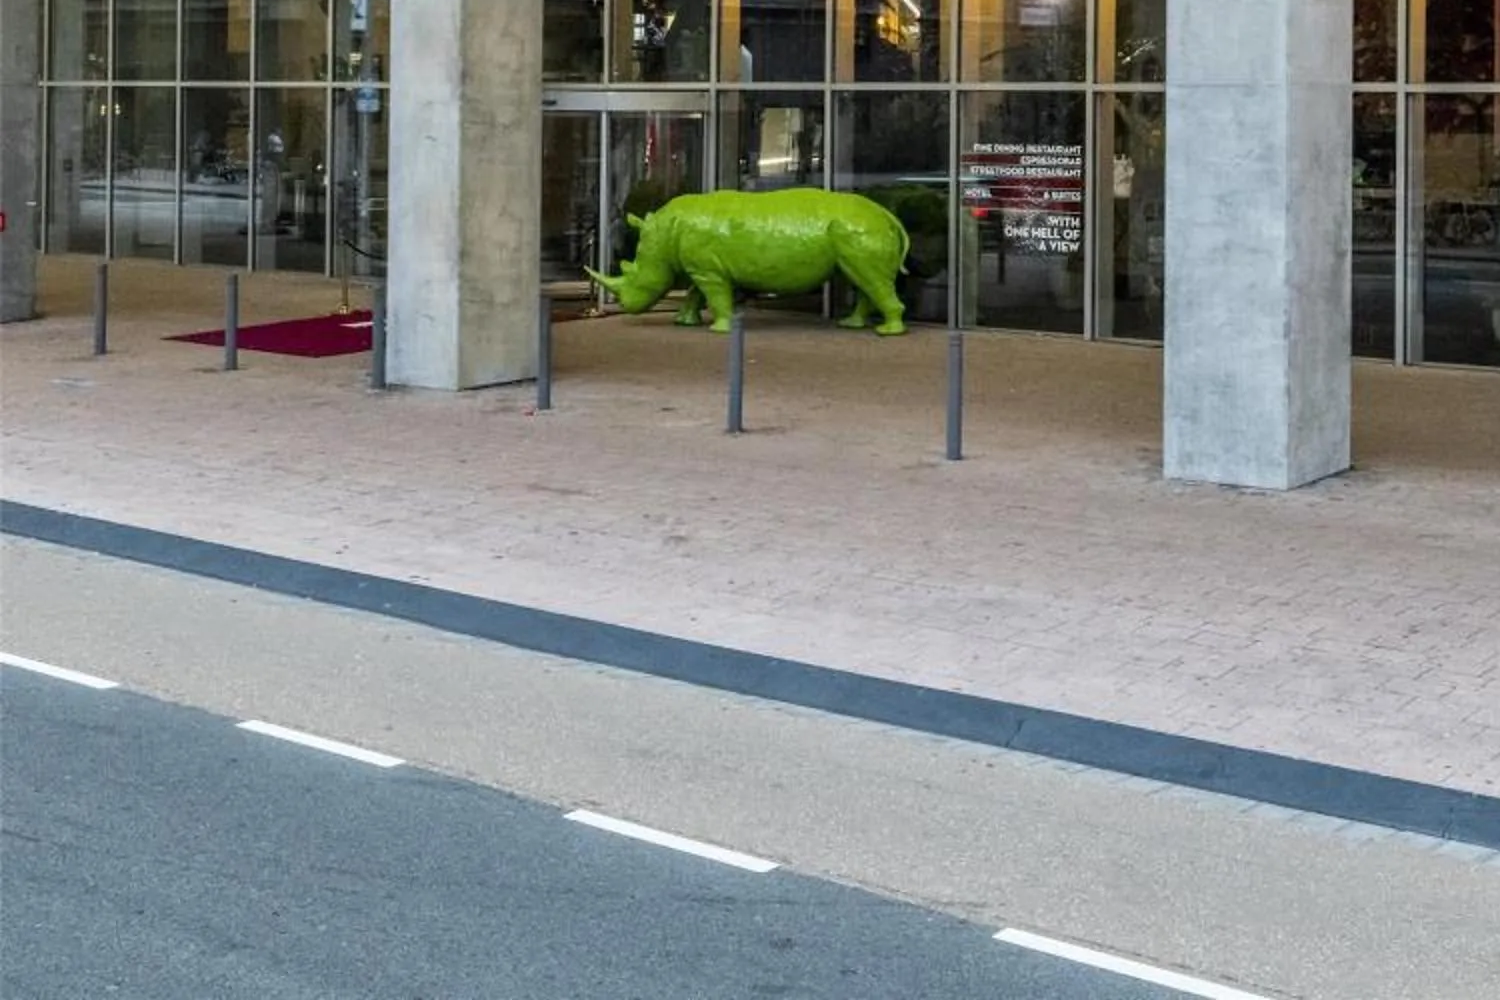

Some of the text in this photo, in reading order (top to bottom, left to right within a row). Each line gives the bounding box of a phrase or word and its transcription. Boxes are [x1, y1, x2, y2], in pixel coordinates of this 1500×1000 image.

[1026, 144, 1081, 155] RESTAURANT
[1026, 167, 1081, 177] RESTAURANT
[1048, 216, 1080, 227] WITH
[1004, 227, 1081, 240] ONE HELL OF
[1039, 241, 1080, 252] A VIEW
